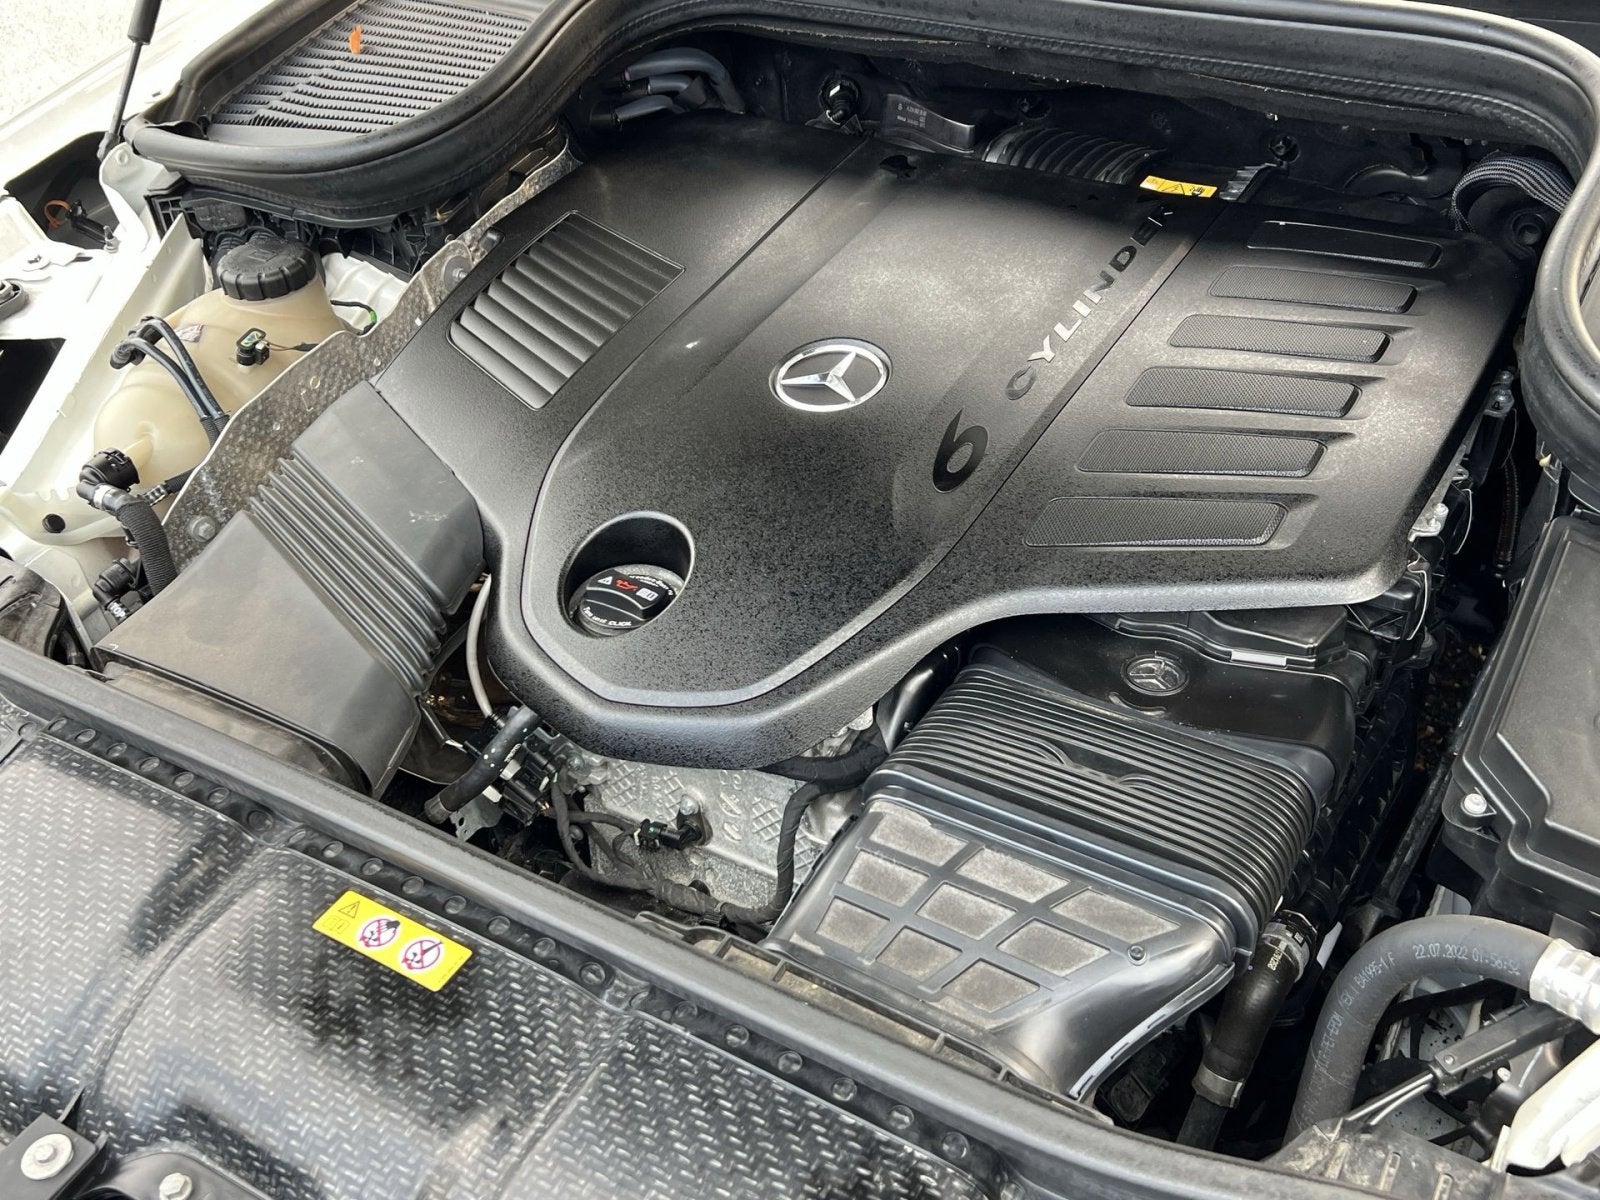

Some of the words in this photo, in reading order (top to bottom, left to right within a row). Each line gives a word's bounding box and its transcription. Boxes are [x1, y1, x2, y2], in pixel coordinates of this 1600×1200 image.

[932, 407, 989, 493] 6
[1005, 203, 1174, 401] CYLINDER
[1412, 943, 1469, 960] 22.07.2022
